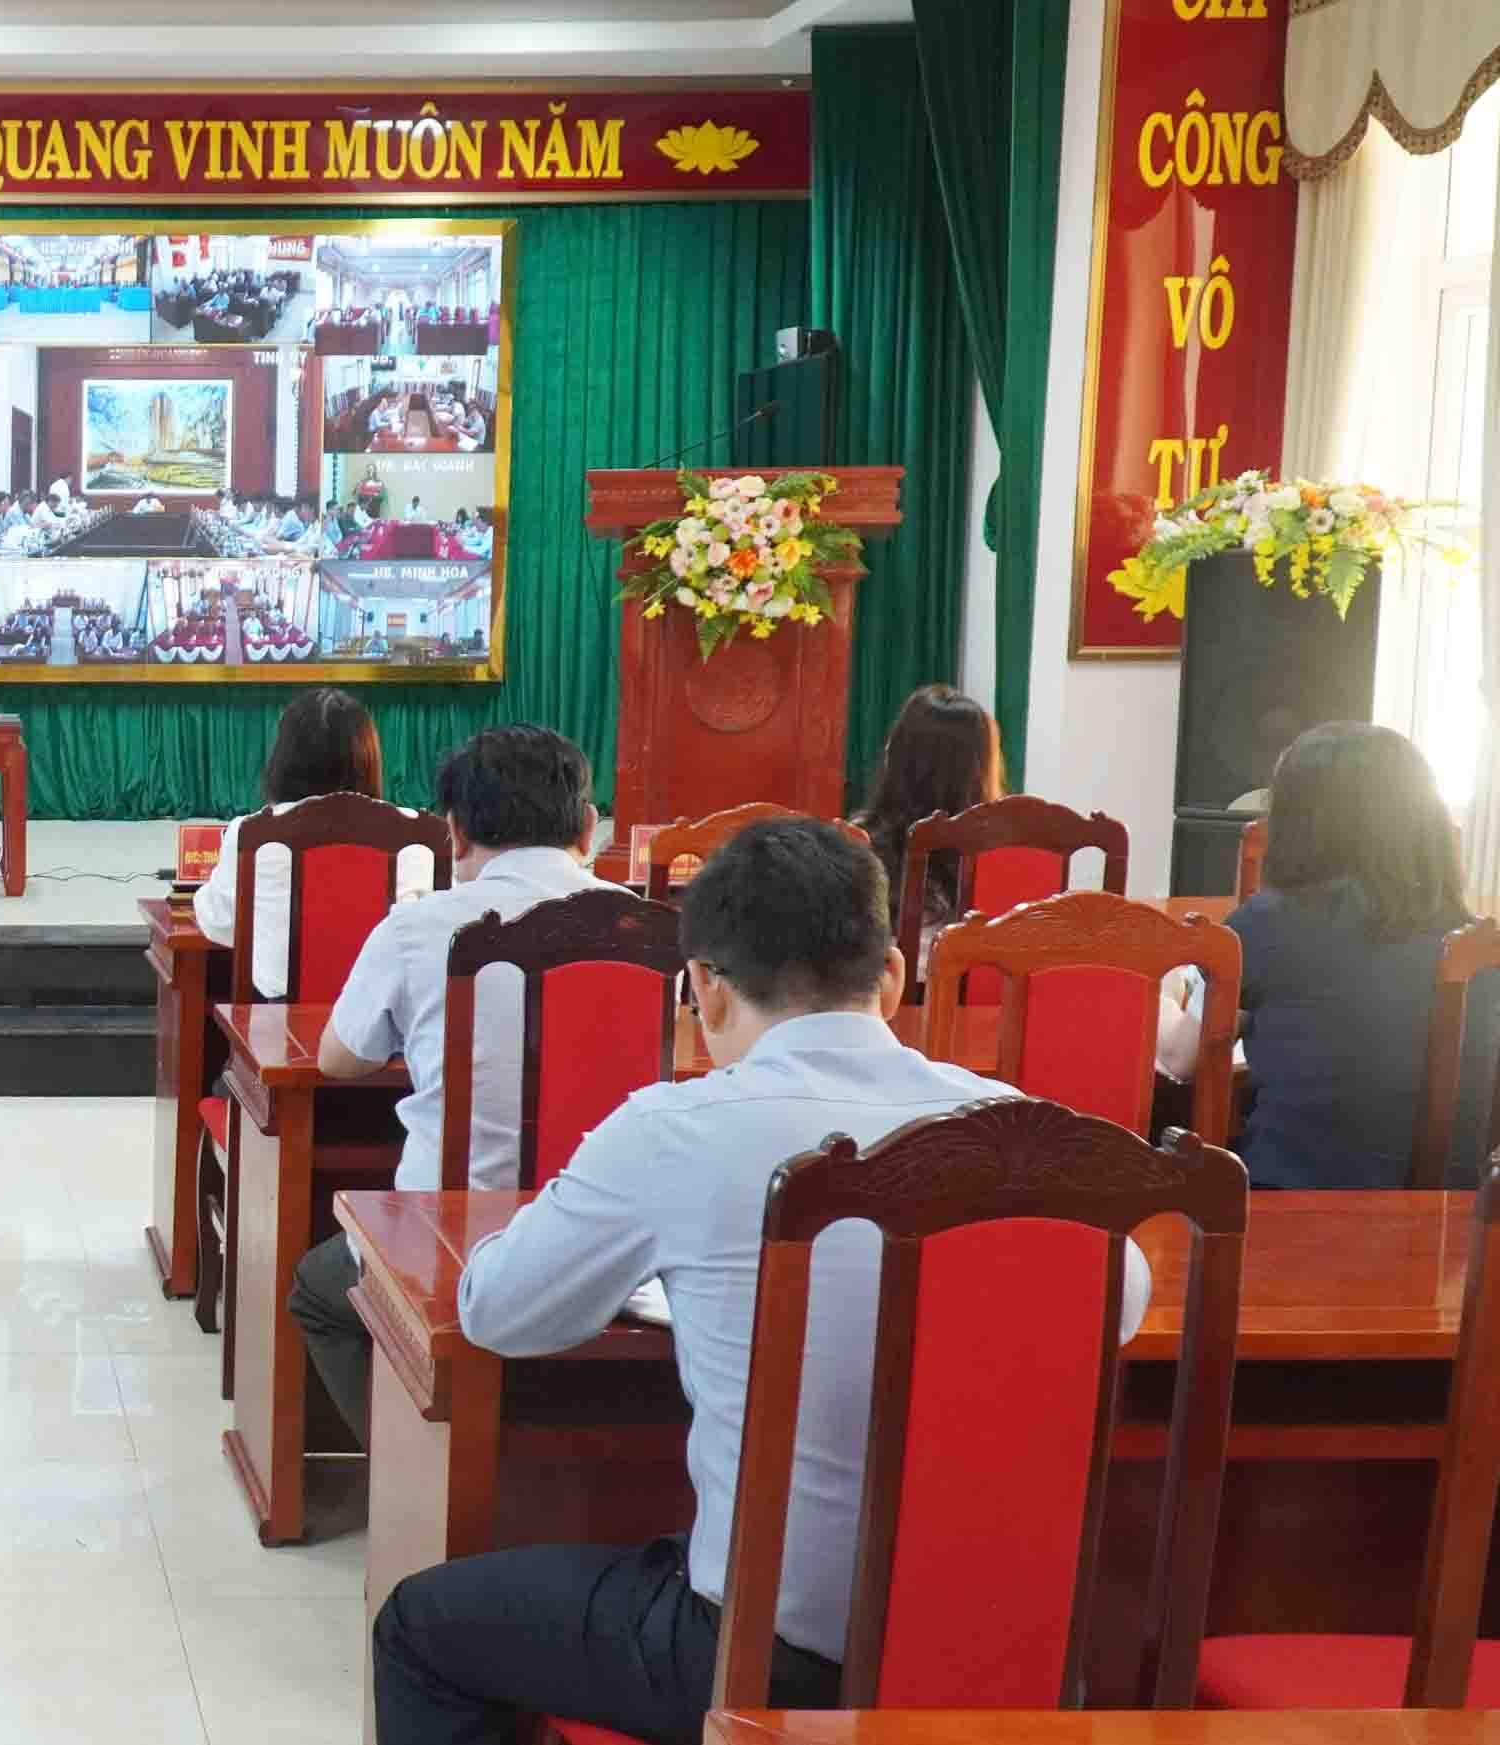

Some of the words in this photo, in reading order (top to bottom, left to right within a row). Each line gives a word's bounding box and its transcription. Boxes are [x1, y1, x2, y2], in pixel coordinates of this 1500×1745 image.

[164, 119, 312, 179] VINH
[323, 101, 488, 179] MUÔN
[497, 101, 626, 179] NĂM
[1138, 88, 1284, 188] CÔNG
[1163, 255, 1236, 350] VÔ
[1148, 424, 1229, 511] TƯ
